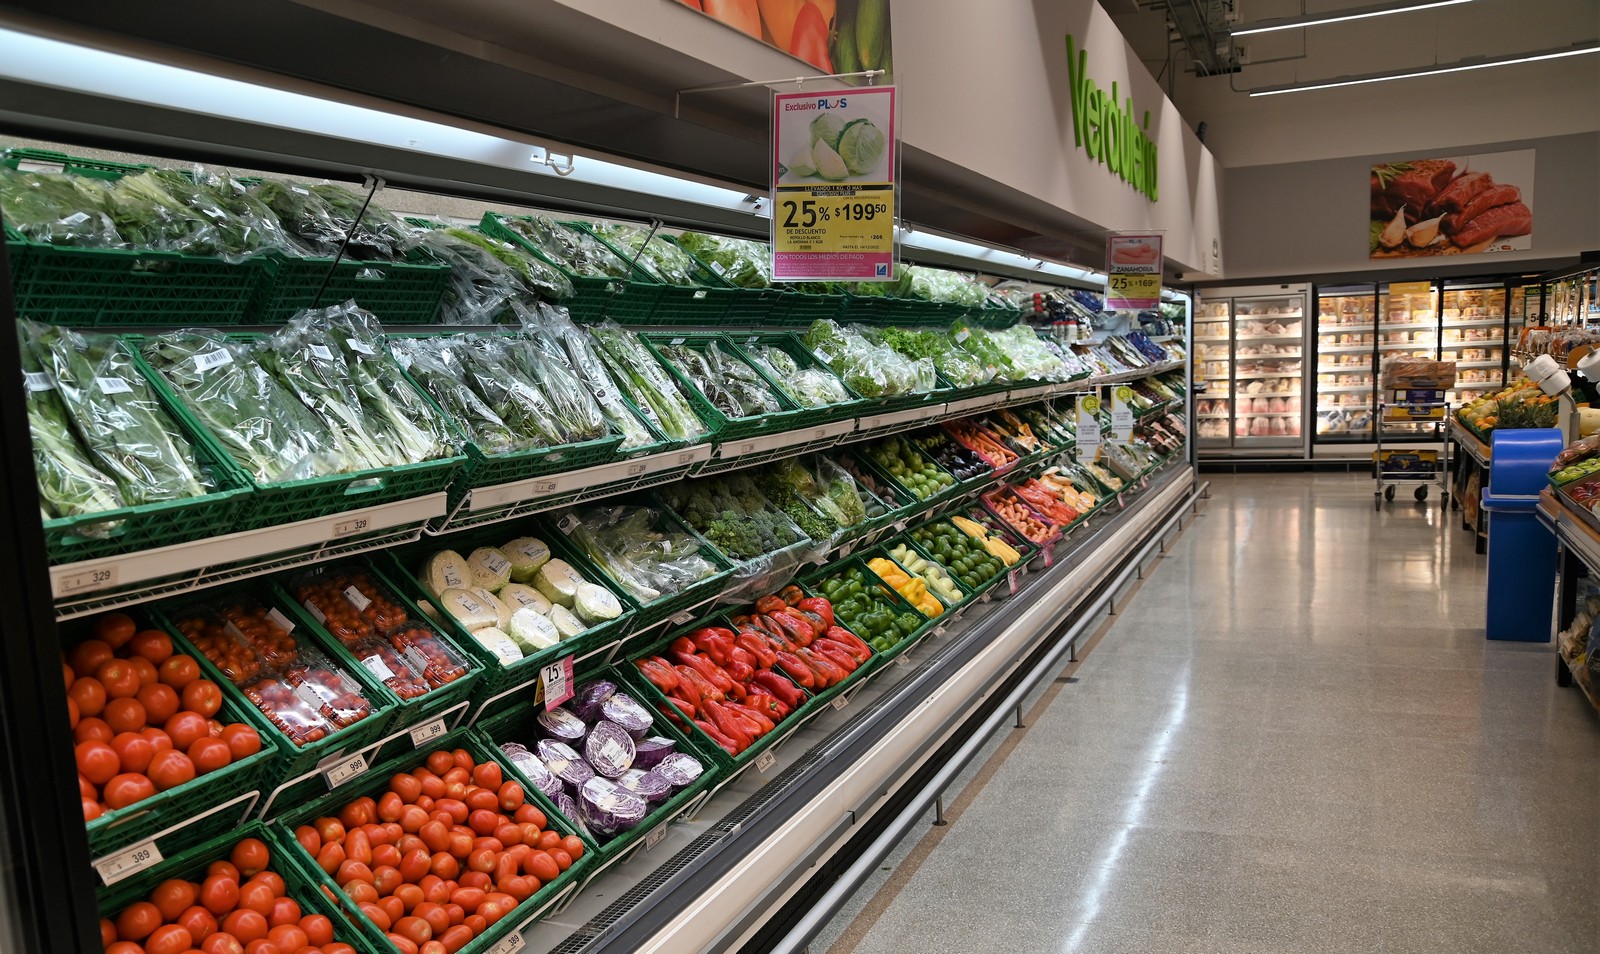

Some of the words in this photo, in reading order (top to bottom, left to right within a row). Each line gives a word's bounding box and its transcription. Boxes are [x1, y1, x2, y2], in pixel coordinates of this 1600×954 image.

[785, 102, 816, 111] Exclusivo
[818, 98, 847, 110] PLUS
[355, 520, 367, 529] 329
[93, 570, 110, 582] 329
[430, 724, 441, 735] 999
[350, 759, 363, 771] 999
[132, 850, 150, 863] 389
